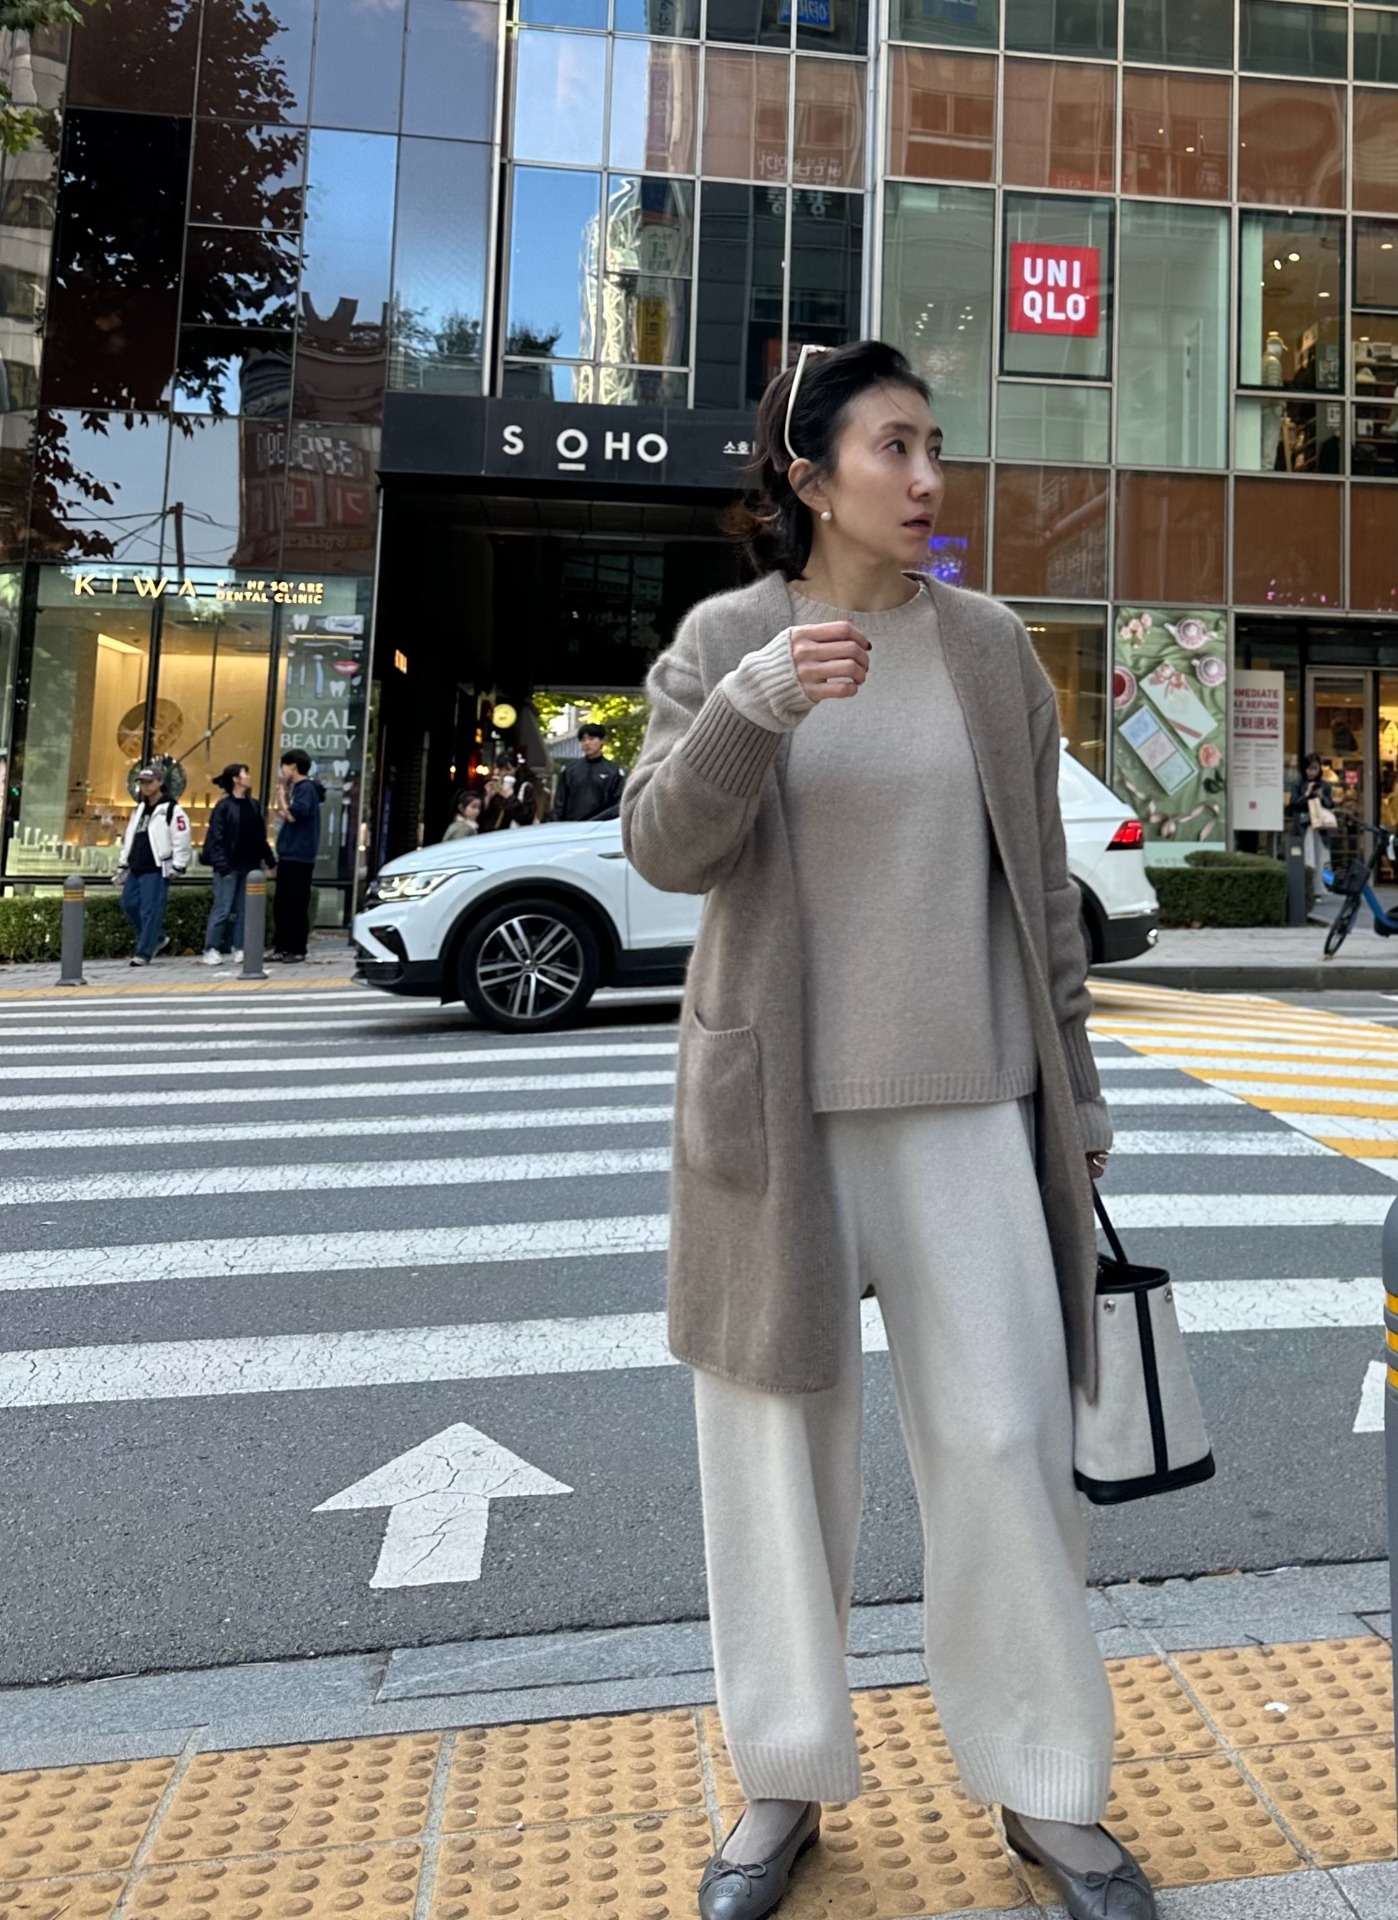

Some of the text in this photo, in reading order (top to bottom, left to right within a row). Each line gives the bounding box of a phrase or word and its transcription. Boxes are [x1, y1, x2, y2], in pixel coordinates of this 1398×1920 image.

[1023, 257, 1081, 289] UNI
[1022, 290, 1086, 324] QLO
[215, 590, 322, 605] DENTAL CLINIC
[281, 707, 357, 730] ORAL
[280, 732, 356, 750] BEAUTY
[176, 815, 187, 832] 5
